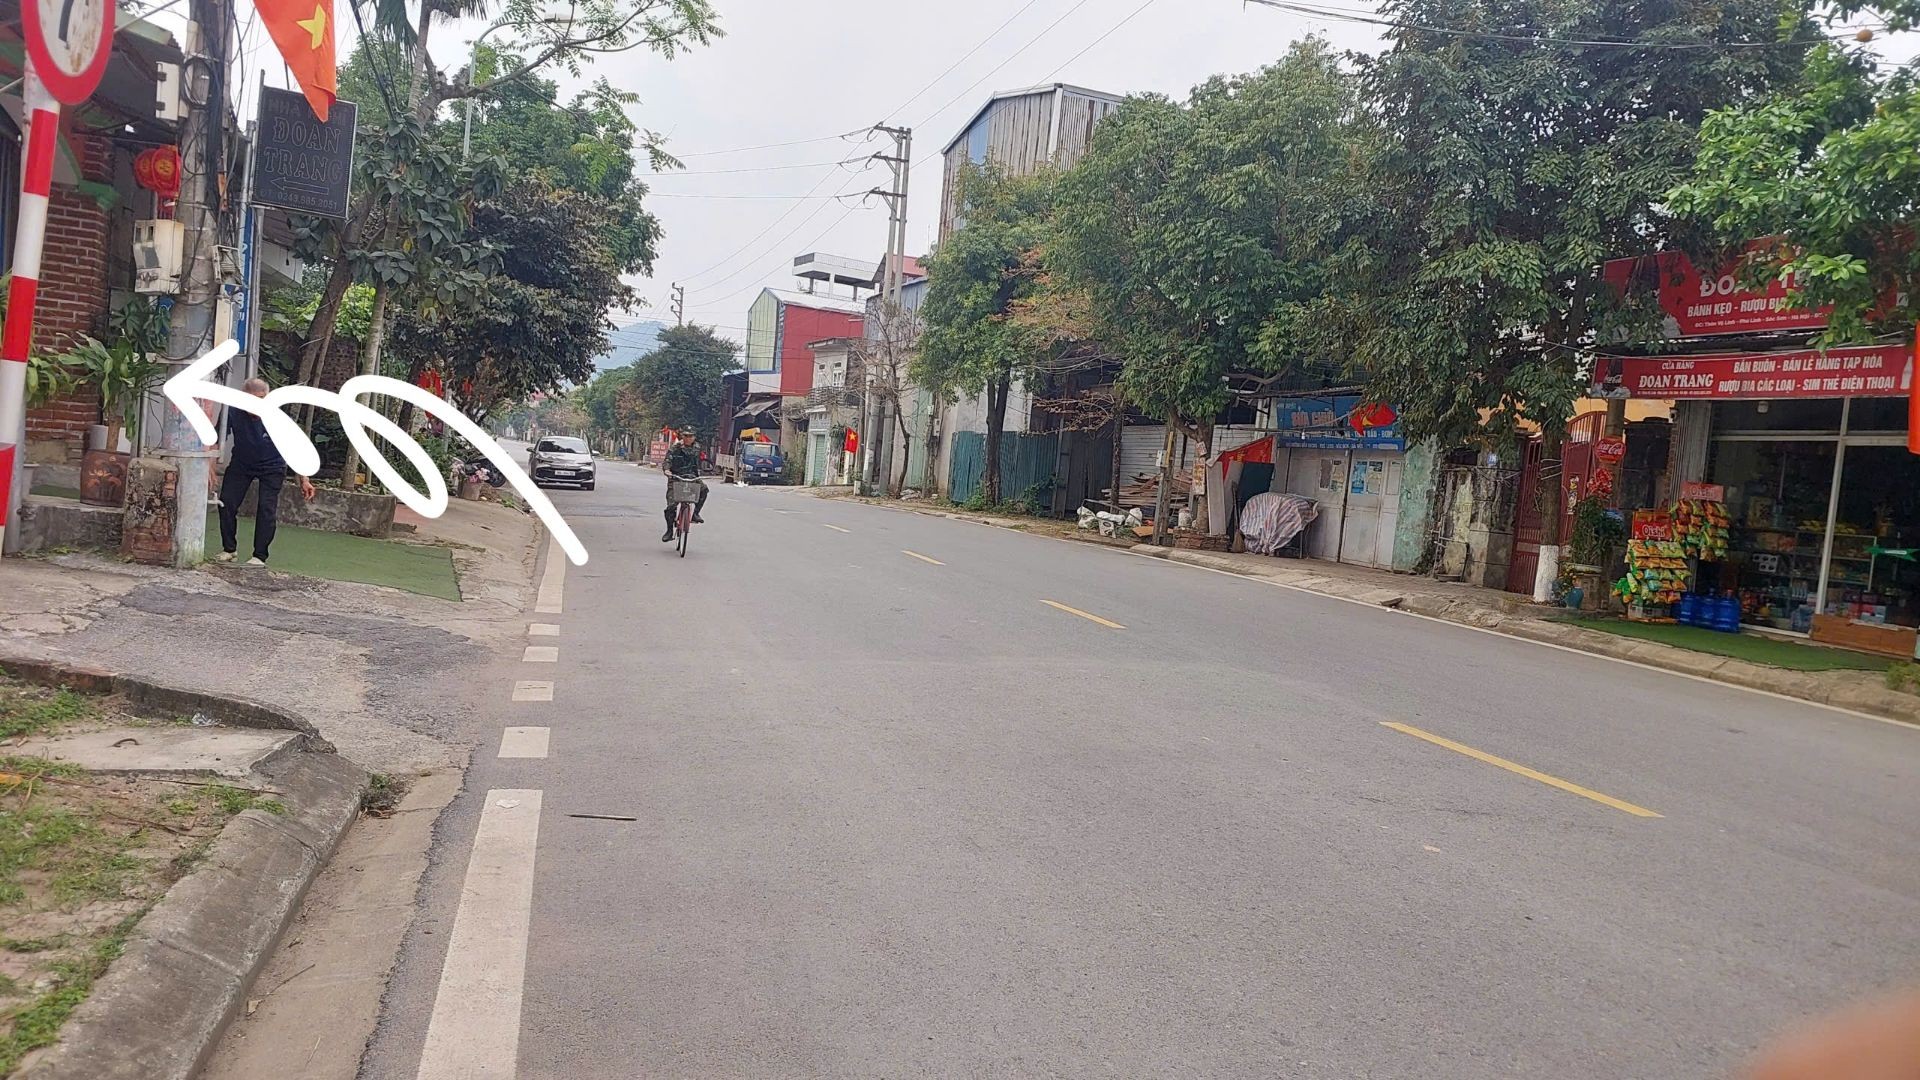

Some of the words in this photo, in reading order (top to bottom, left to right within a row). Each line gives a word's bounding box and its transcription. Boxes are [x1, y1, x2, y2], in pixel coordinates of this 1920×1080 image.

[272, 116, 341, 154] ĐOAN
[263, 147, 344, 185] TRANG
[1687, 303, 1713, 317] BÁNH
[1714, 302, 1732, 317] KẸO
[1676, 360, 1695, 370] HÀNG
[1733, 358, 1751, 373] BÁN
[1752, 358, 1776, 373] BUÔN
[1782, 357, 1801, 372] BÁN
[1803, 355, 1814, 371] LẺ
[1816, 356, 1841, 370] HÀNG
[1842, 356, 1860, 372] TẠP
[1638, 375, 1672, 388] ĐOAN
[1673, 373, 1714, 387] TRANG
[1718, 380, 1740, 395] RƯỢU
[1741, 379, 1756, 392] BIA
[1757, 377, 1774, 392] CÁC
[1775, 378, 1796, 394] LOẠI
[1803, 377, 1820, 391] SIM
[1822, 374, 1840, 390] THẺ
[1841, 375, 1865, 393] ĐIỆN
[1866, 376, 1896, 392] THOẠI
[1689, 485, 1715, 497] Oishi
[1641, 525, 1665, 538] Oishi
